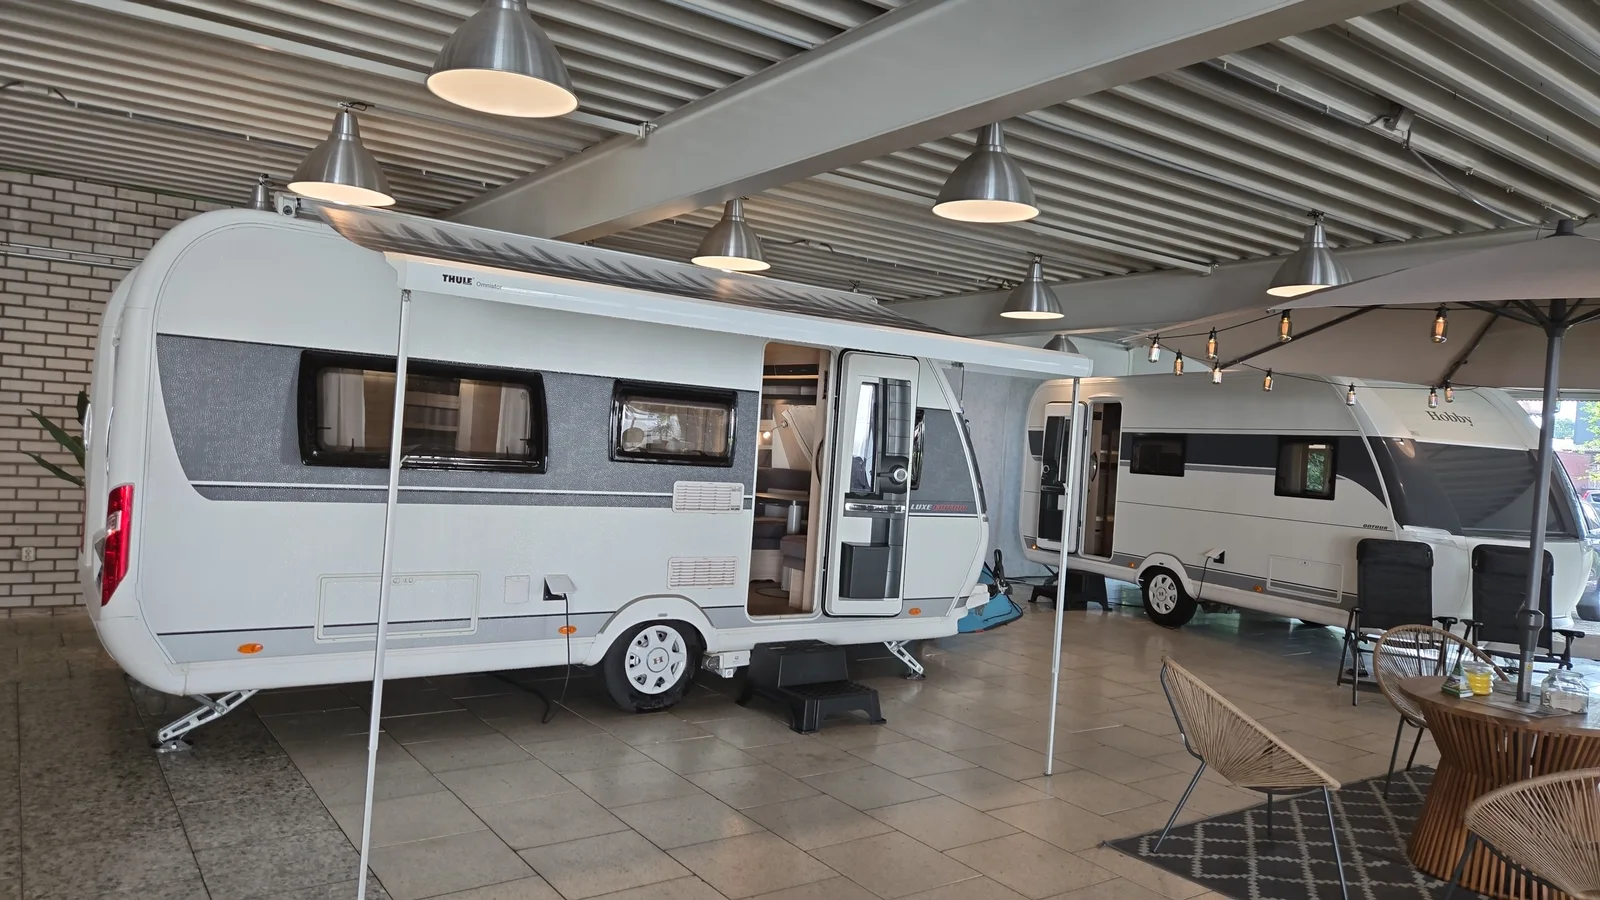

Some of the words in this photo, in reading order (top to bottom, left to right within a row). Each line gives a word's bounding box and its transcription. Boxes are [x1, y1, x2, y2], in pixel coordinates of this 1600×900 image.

[442, 273, 473, 286] THULE
[1425, 410, 1474, 427] Hobby
[910, 503, 932, 511] LUXE
